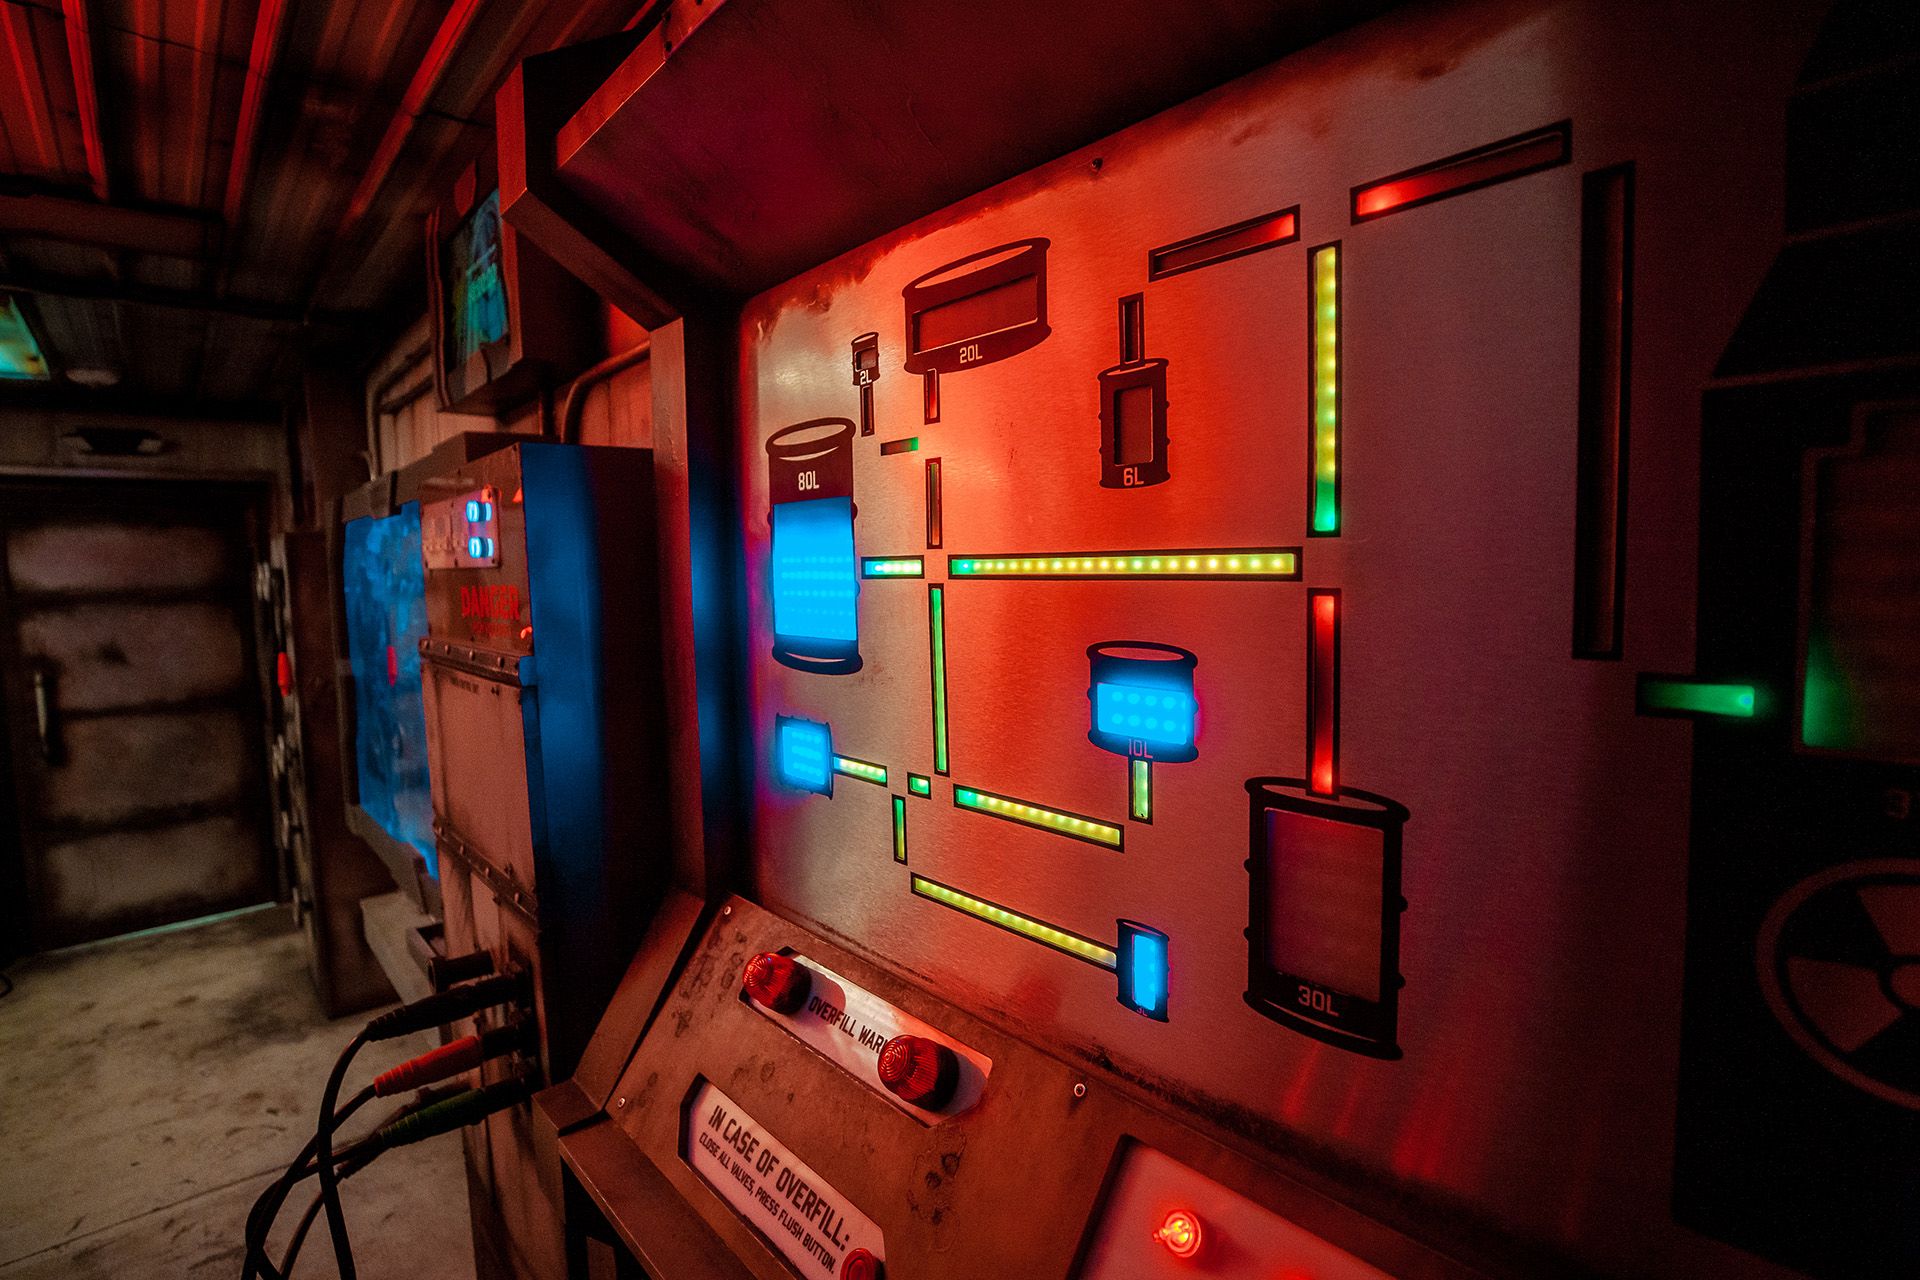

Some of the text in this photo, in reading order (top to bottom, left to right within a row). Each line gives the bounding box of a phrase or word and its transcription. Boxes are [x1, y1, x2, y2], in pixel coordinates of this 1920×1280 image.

[959, 344, 983, 363] 20L
[859, 370, 873, 385] 2L
[798, 470, 820, 491] 80L
[1123, 466, 1145, 487] 6L
[461, 585, 520, 620] DANGER
[1128, 738, 1154, 759] 10L
[1297, 984, 1341, 1018] 30L
[808, 996, 857, 1037] OVERFILL
[708, 1105, 850, 1252] IN CASE OF OVERFILL:
[699, 1132, 836, 1275] CLOSE ALL VALVES, PRESS FLUSH BUTTON.
